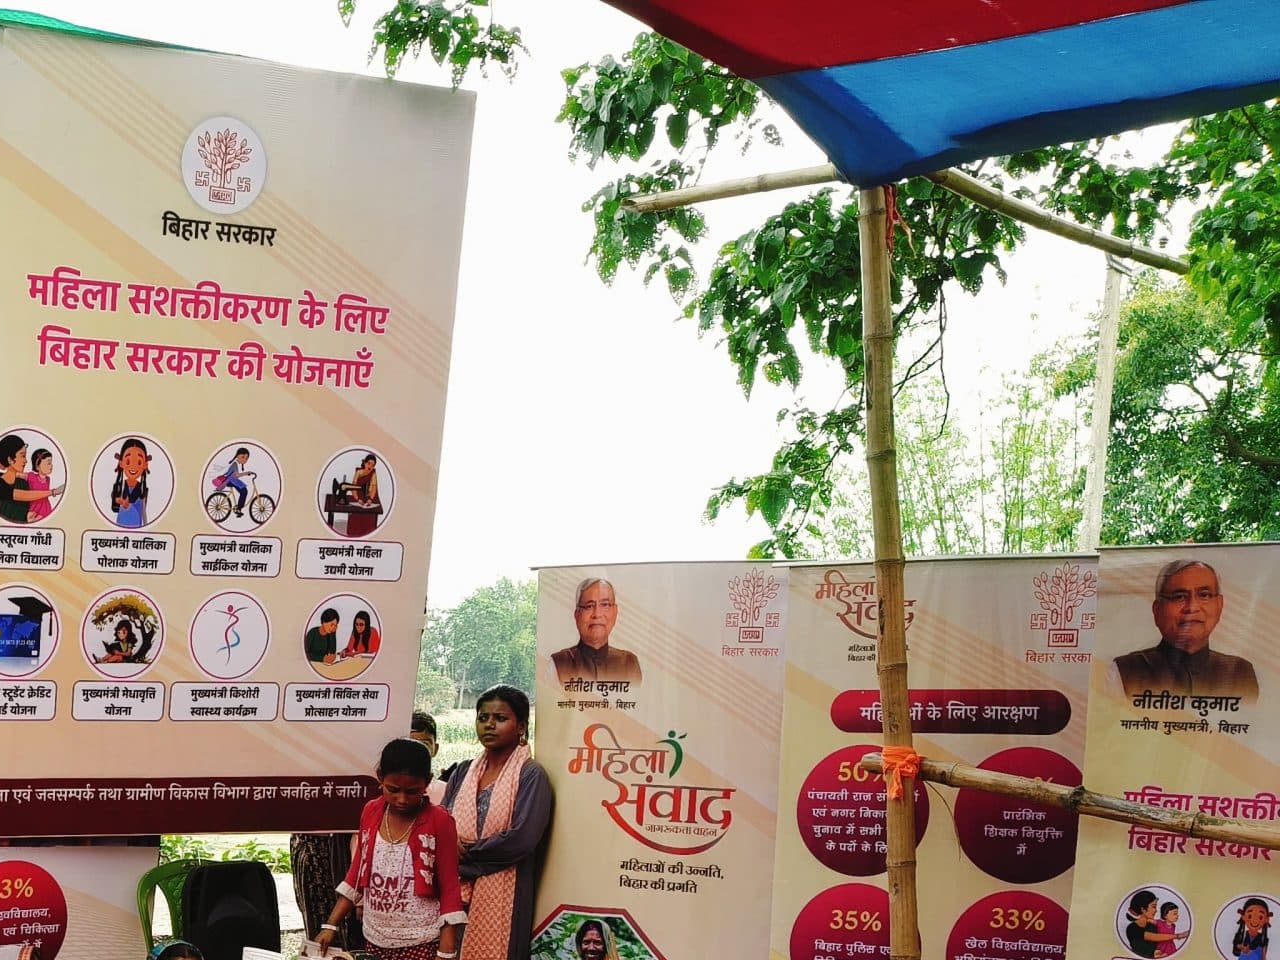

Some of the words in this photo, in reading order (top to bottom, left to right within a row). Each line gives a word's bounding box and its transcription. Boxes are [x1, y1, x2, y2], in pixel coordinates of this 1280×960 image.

[162, 211, 210, 241] बिहार
[215, 222, 276, 247] सरकार
[27, 266, 120, 312] महिला
[128, 280, 292, 327] सशक्तीकरण
[297, 290, 327, 327] के
[334, 293, 390, 335] लिए
[37, 325, 120, 370] बिहार
[126, 341, 220, 379] सरकार
[227, 342, 266, 382] की
[273, 346, 374, 389] योजनाएँ
[91, 537, 129, 552] मुख्यमंत्री
[131, 537, 167, 551] बालिका
[199, 540, 237, 556] मुख्यमंत्री
[239, 541, 272, 555] बालिका
[20, 552, 59, 566] विद्यालय
[319, 545, 353, 560] मुख्यमंत्री
[356, 546, 382, 559] महिला
[97, 555, 128, 569] पोशाक
[131, 557, 158, 570] योजना
[241, 561, 268, 574] योजना
[324, 563, 346, 576] उद्यमी
[348, 564, 374, 577] योजना
[721, 645, 744, 657] बिहार
[749, 648, 779, 658] सरकार
[1025, 650, 1055, 664] बिहार
[1060, 651, 1091, 664] सरका
[82, 686, 119, 702] मुख्यमंत्री
[191, 686, 226, 702] मुख्यमंत्री
[229, 686, 260, 700] किशोरी
[296, 687, 331, 703] मुख्यमंत्री
[333, 687, 360, 700] सिविल
[361, 688, 379, 700] सेवा
[596, 680, 630, 696] कुमार
[10, 704, 37, 717] योजना
[615, 699, 636, 710] बिहार
[1132, 689, 1186, 711] नीतीश
[1190, 693, 1242, 717] कुमार
[104, 705, 132, 717] योजना
[190, 706, 221, 718] स्वास्थ्य
[223, 704, 258, 718] कार्यक्रम
[304, 704, 339, 719] प्रोत्साहन
[341, 705, 367, 718] योजना
[927, 703, 942, 720] के
[946, 700, 976, 720] लिए
[982, 705, 1040, 724] आरक्षण
[1120, 718, 1158, 731] माननीय
[1218, 719, 1250, 735] बिहार
[568, 723, 669, 775] महिला
[13, 784, 32, 803] एवं
[36, 783, 94, 802] जनसम्पर्क
[99, 786, 121, 802] तथा
[125, 781, 165, 801] ग्रामीण
[169, 781, 209, 801] विकास
[213, 781, 249, 801] विभाग
[252, 785, 276, 805] द्वारा
[280, 780, 318, 800] जनहित
[322, 781, 335, 796] में
[601, 765, 736, 831] संवाद
[808, 789, 847, 802] पंचायती
[812, 807, 827, 818] एवं
[831, 807, 856, 819] नगर
[1003, 808, 1046, 821] प्रारंभिक
[812, 824, 841, 838] चुनाव
[859, 823, 881, 836] सभी
[984, 824, 1018, 839] शिक्षक
[826, 840, 835, 851] के
[861, 841, 871, 853] के
[875, 840, 888, 854] लि
[1128, 824, 1189, 855] बिहार
[1016, 844, 1027, 857] में
[620, 858, 664, 874] महिलाओं
[668, 861, 683, 875] की
[620, 875, 649, 890] बिहार
[650, 876, 665, 891] की
[830, 909, 882, 932] 35%
[989, 907, 1045, 931] 33%
[4, 923, 16, 937] एवं
[19, 922, 60, 936] चिकित्सा
[814, 939, 842, 953] बिहार
[846, 941, 876, 957] पुलिस
[965, 937, 988, 949] खेल
